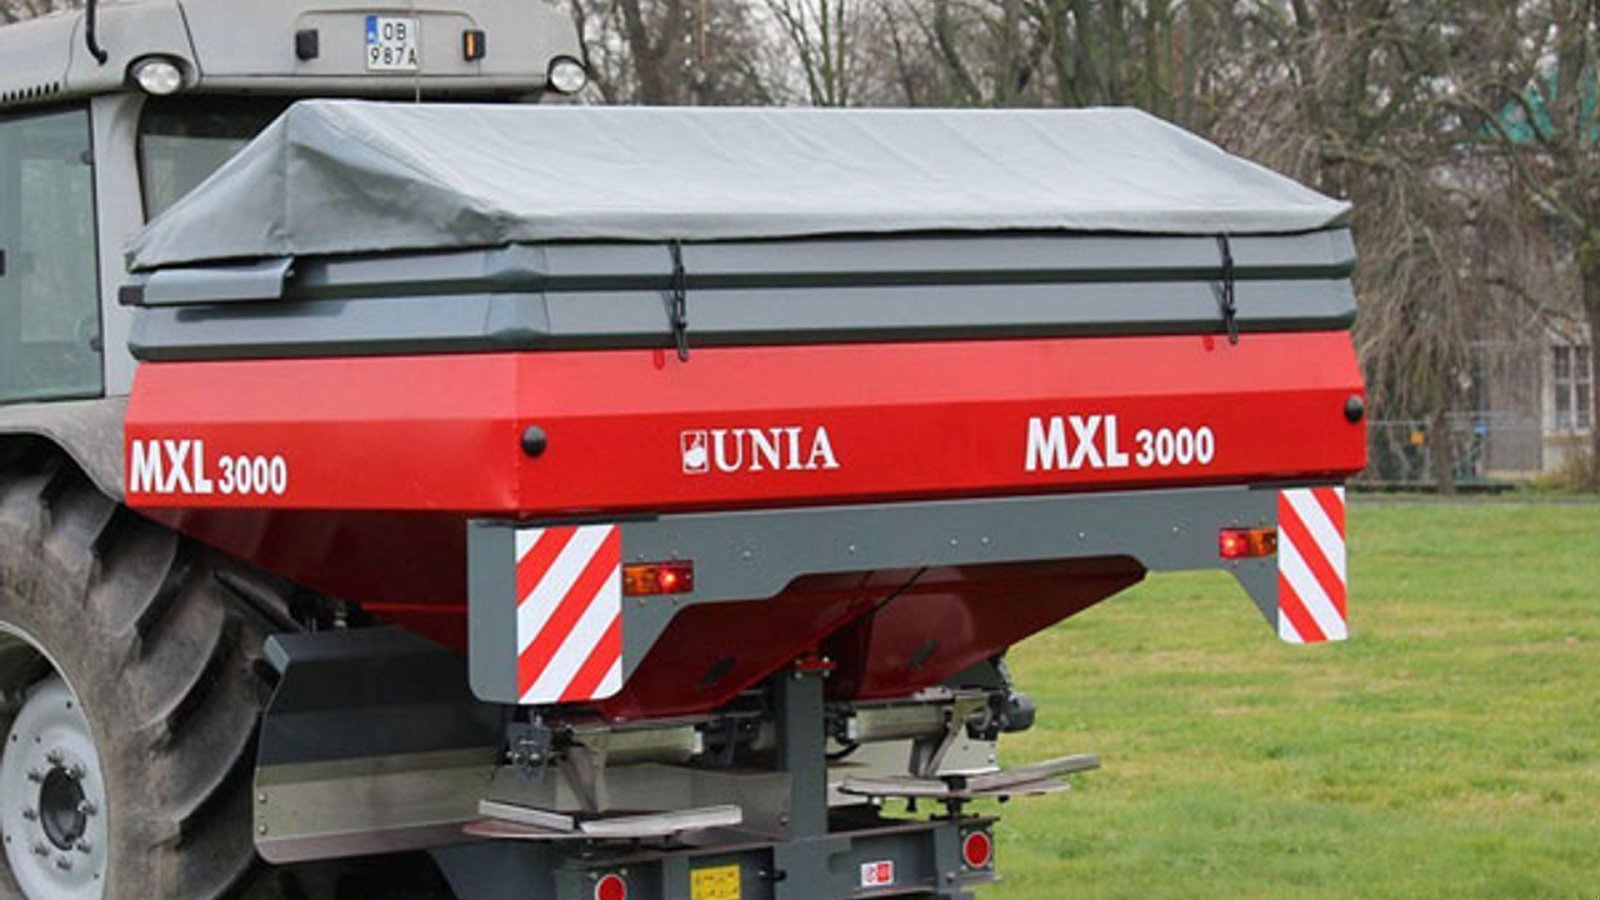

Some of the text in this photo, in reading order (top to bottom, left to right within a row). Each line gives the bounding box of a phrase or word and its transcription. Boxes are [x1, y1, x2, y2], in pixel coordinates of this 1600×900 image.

[370, 47, 417, 65] 987A
[130, 439, 287, 494] MXL 3000
[710, 426, 840, 472] UNIA
[1025, 414, 1215, 471] MXL 3000
